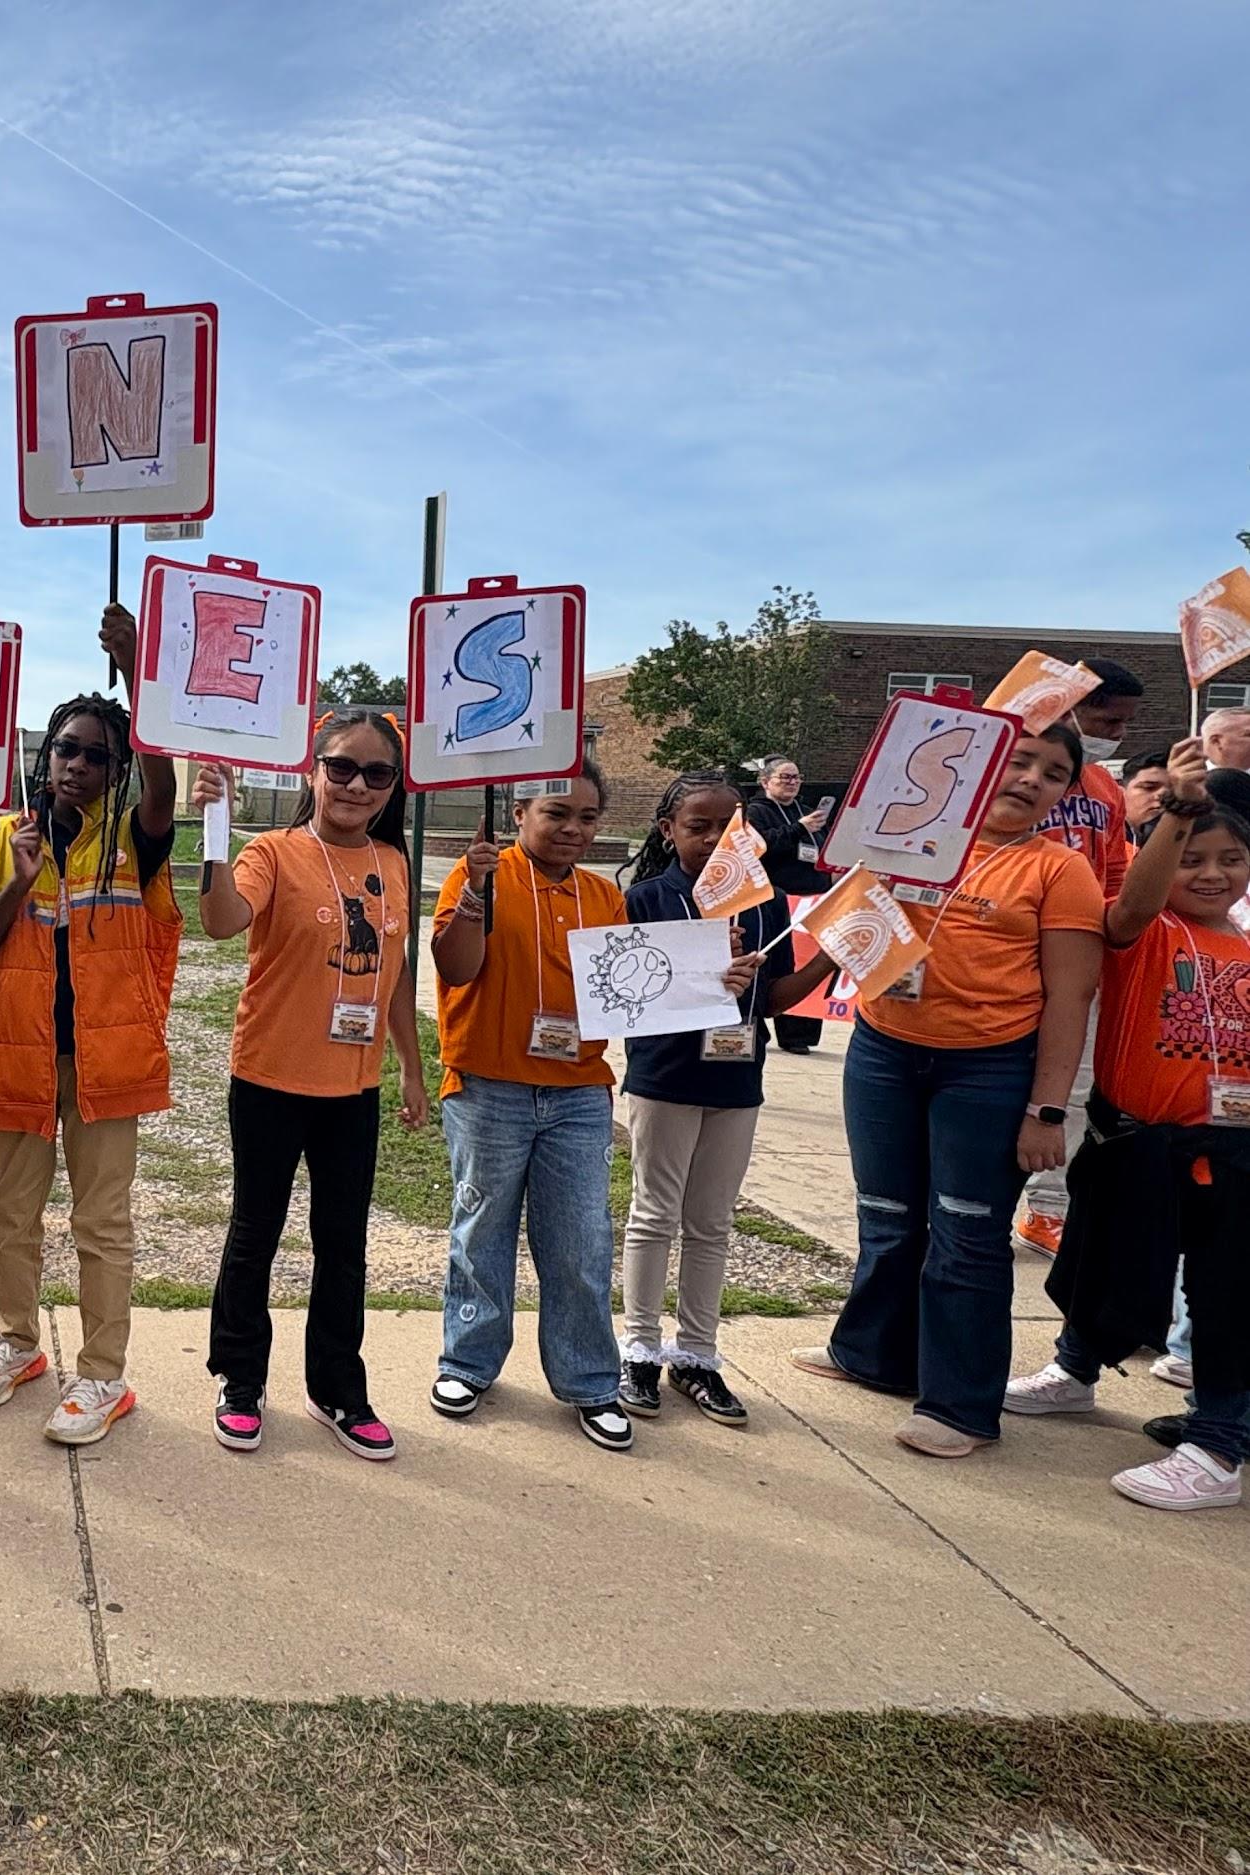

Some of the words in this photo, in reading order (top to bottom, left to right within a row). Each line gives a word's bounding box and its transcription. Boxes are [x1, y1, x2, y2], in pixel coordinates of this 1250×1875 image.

[67, 336, 166, 469] N
[184, 589, 268, 704] E
[453, 611, 534, 742] S
[874, 727, 977, 835] S
[828, 1001, 848, 1017] TO
[1219, 1017, 1244, 1032] FOR
